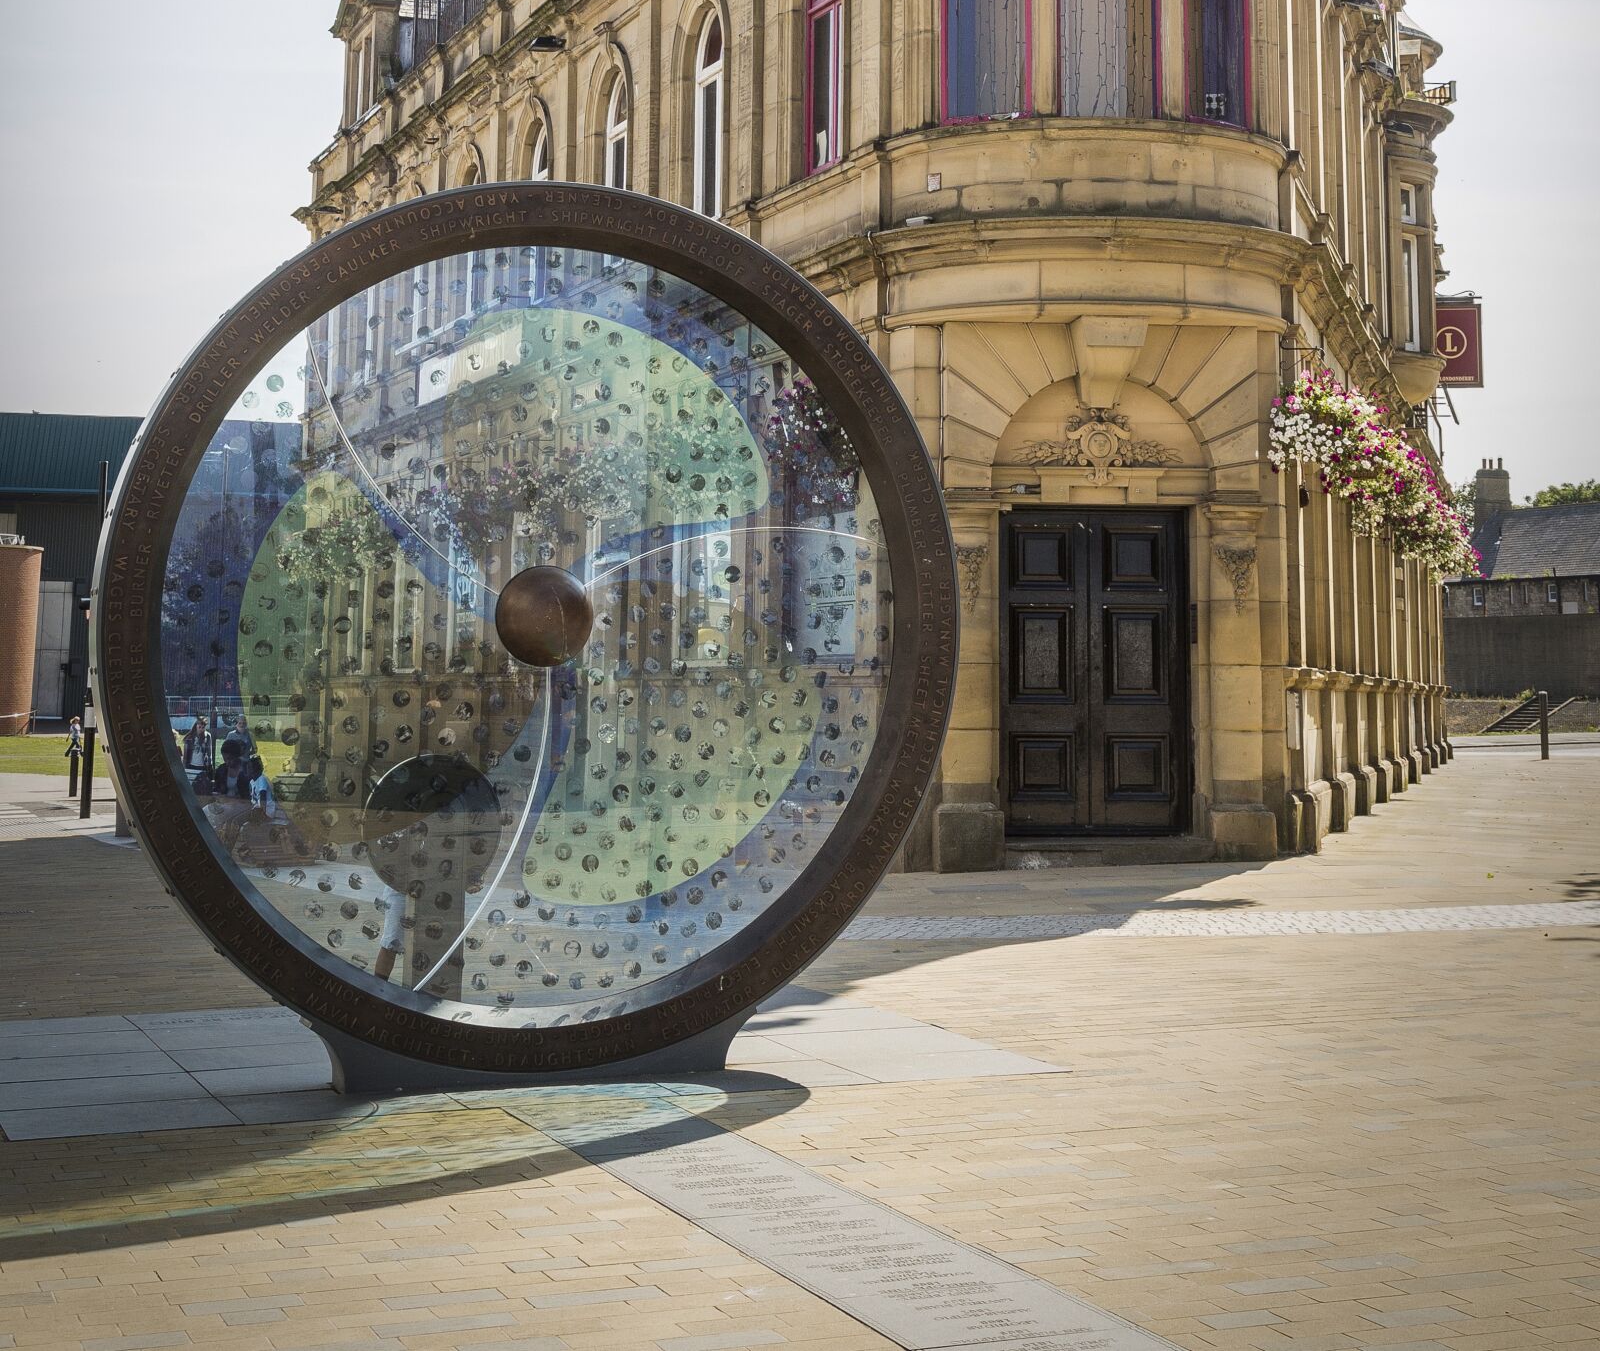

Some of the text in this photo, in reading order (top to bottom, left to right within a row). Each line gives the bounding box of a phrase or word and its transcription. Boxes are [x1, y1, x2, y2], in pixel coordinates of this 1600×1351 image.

[349, 197, 464, 249] ACCOUNTANT
[419, 210, 527, 241] SHIPWRIGHT
[474, 191, 520, 207] YARD
[544, 190, 625, 211] CLEANER
[550, 209, 657, 238] SHIPWRIGHT
[642, 204, 680, 226] BOY
[324, 236, 401, 286] CAULKER
[659, 230, 746, 278] LINER-OFF
[684, 220, 743, 257] OFFICE
[239, 249, 331, 328] PERSONNEL
[758, 283, 815, 333] STAGER
[759, 261, 835, 328] OPERATOR
[248, 287, 311, 347] WELDER
[1445, 332, 1457, 352] L
[175, 323, 241, 406] MANAGER
[833, 328, 872, 372] ROOM
[187, 354, 241, 425] DRILLER
[821, 342, 893, 445] STOREKEEPER
[868, 376, 904, 424] PRINT
[120, 423, 171, 530] SECRETARY
[145, 442, 185, 520] RIVETER
[906, 449, 935, 504] CLERK
[895, 471, 927, 550] PLUMBER
[926, 512, 947, 556] PLAN
[108, 554, 128, 621] WAGES
[129, 542, 152, 617] BURNER
[918, 571, 934, 632] FITTER
[937, 580, 952, 667] MANAGER
[108, 632, 124, 695] CLERK
[128, 640, 151, 720] TURNER
[913, 655, 931, 710] SHEET
[895, 715, 922, 772] METAL
[913, 675, 947, 776] TECHNICAL
[116, 718, 162, 824] LOFTSMAN
[139, 724, 172, 790] FRAME
[860, 776, 903, 847] WORKER
[864, 795, 915, 876] MANAGER
[170, 809, 214, 876] PLATER
[224, 893, 287, 958] PAINTER
[773, 859, 856, 950] BLACKSMITH
[830, 879, 867, 921] YARD
[229, 930, 284, 984] MAKER
[769, 932, 821, 979] BUYER
[302, 963, 361, 1007] JOINER
[304, 990, 359, 1031] NAVAL
[364, 1022, 471, 1062] ARCHITECT
[383, 1005, 475, 1043] OPERATOR
[565, 1016, 633, 1042] RIGGER
